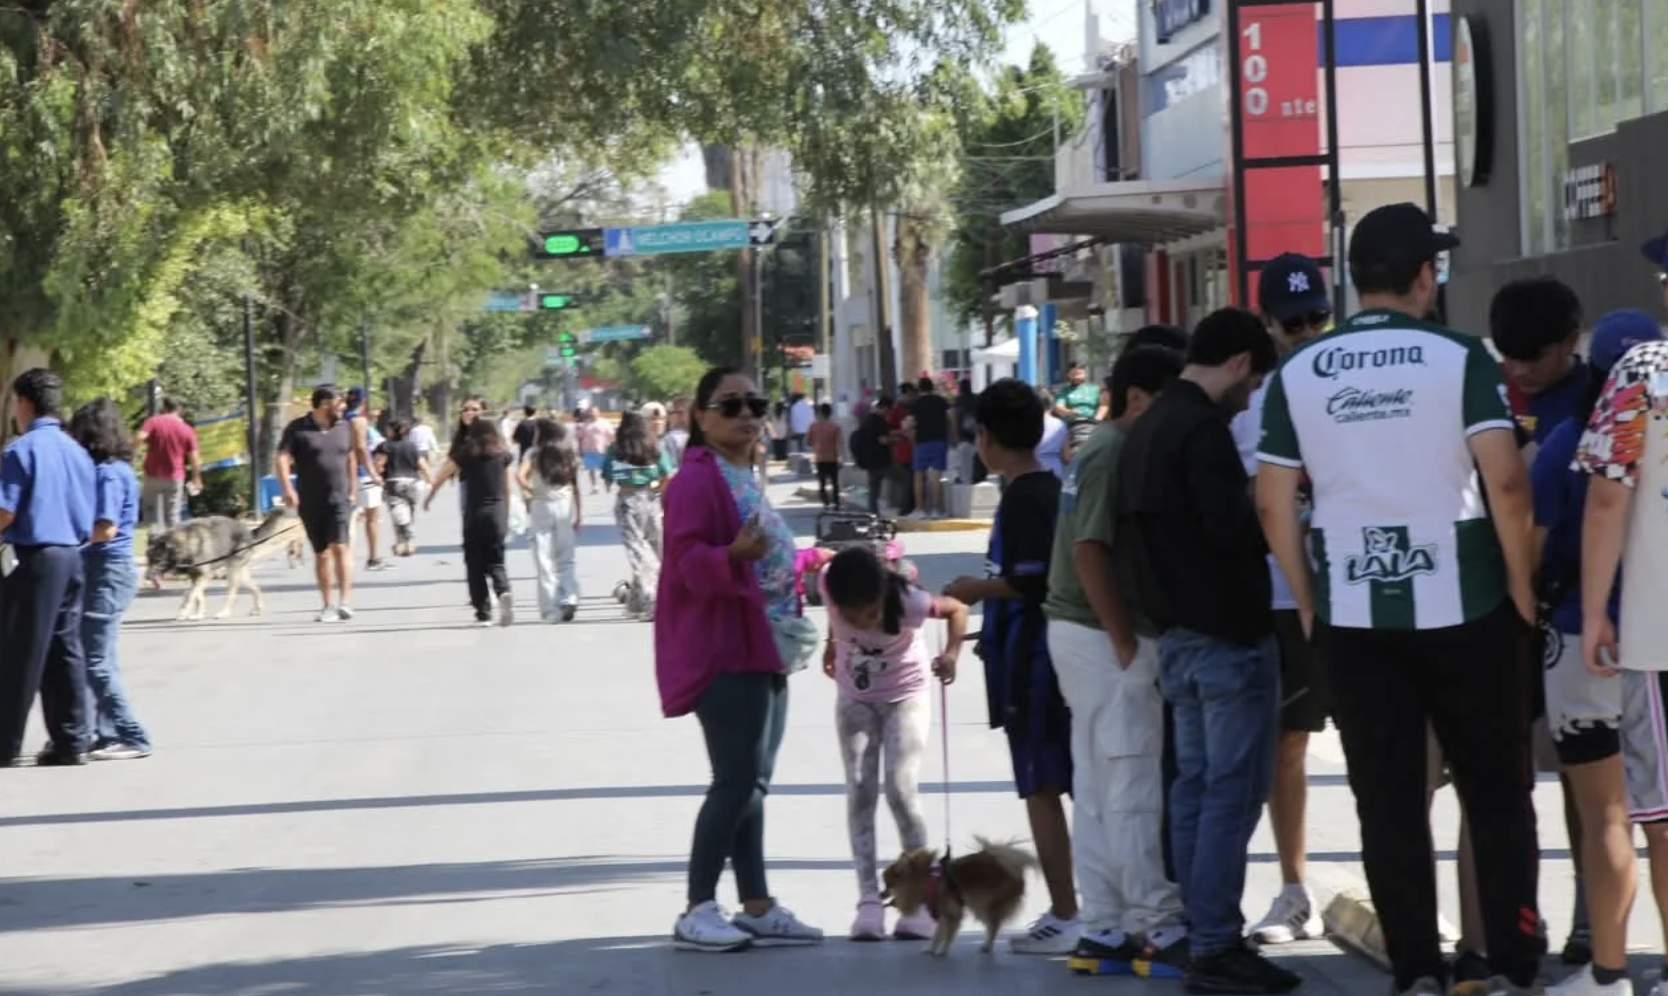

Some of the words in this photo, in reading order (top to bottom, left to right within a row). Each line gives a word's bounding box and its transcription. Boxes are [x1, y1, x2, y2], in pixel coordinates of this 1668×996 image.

[1242, 22, 1269, 116] 100
[1312, 346, 1425, 380] Corona
[1345, 547, 1436, 583] LALA
